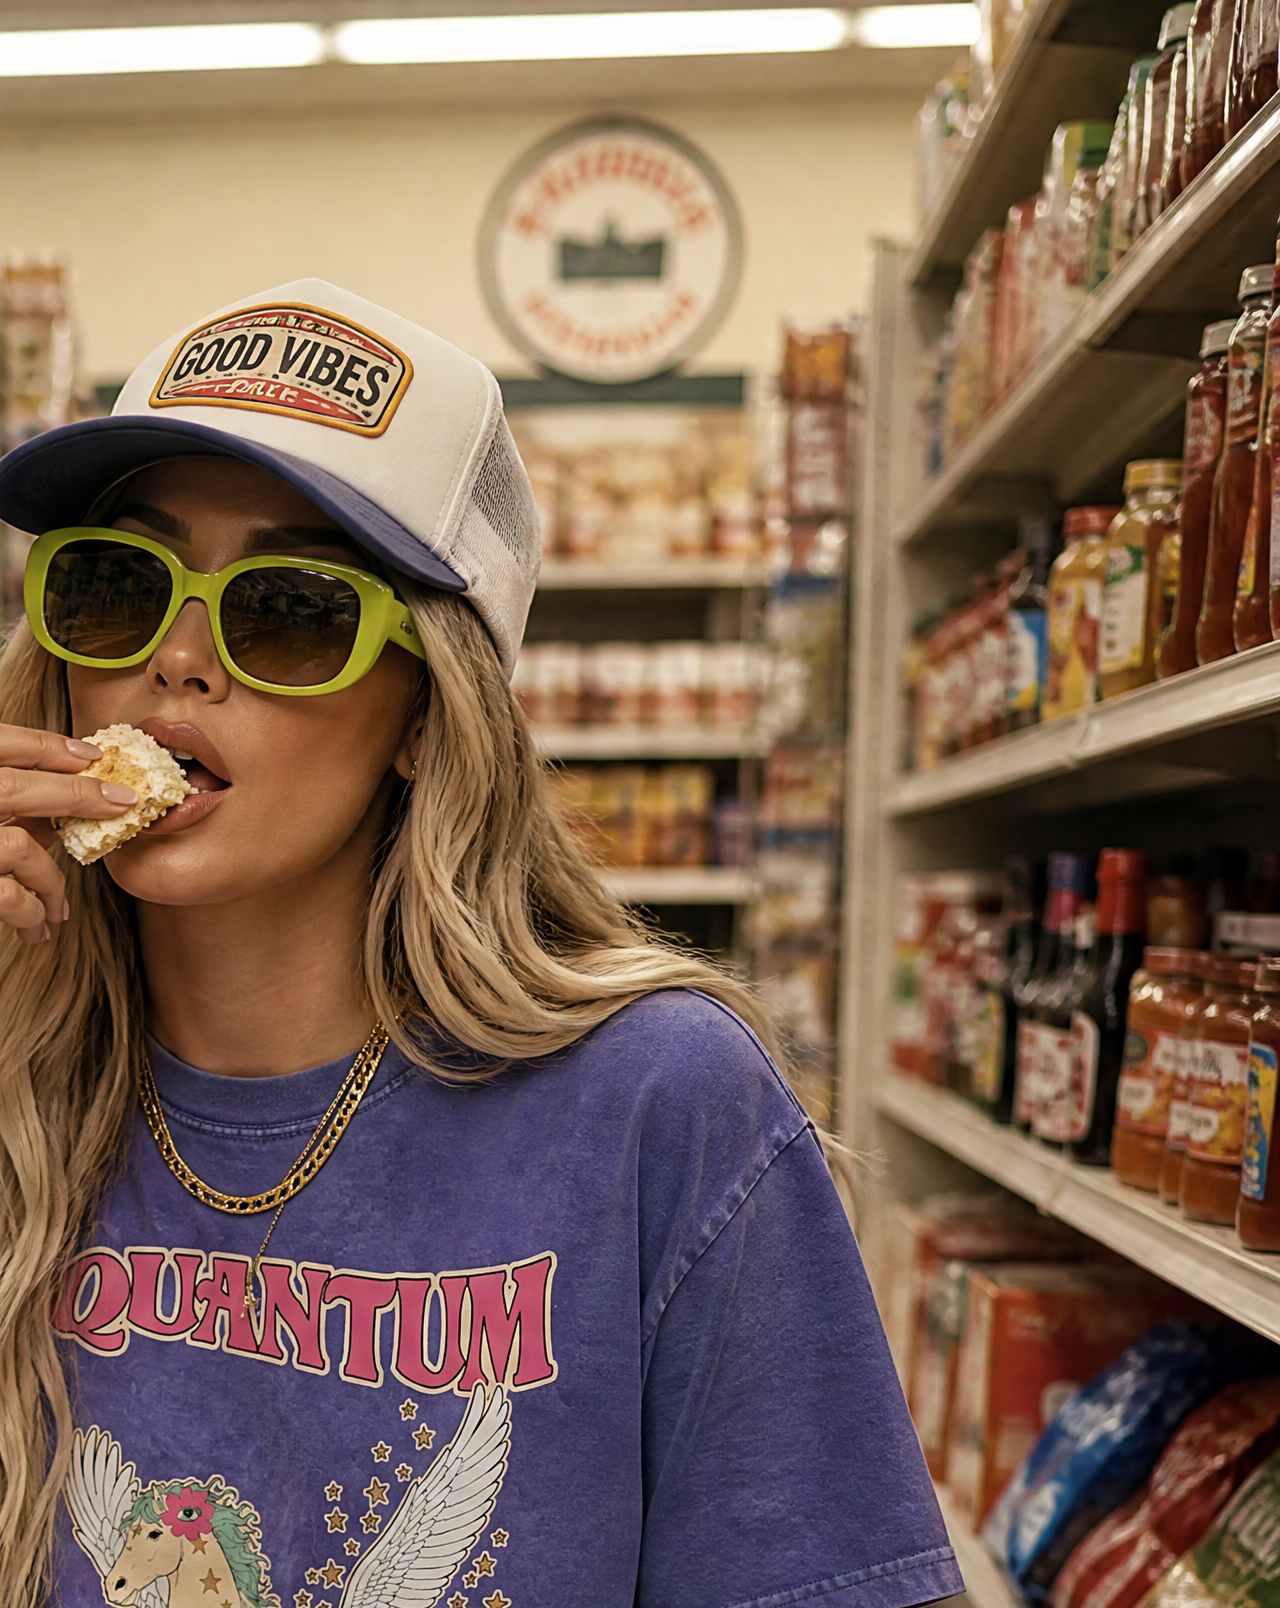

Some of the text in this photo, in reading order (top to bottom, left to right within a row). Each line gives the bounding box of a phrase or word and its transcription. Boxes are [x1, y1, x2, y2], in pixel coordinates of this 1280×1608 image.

[172, 333, 390, 407] GOOD VIBES
[52, 1246, 558, 1396] QUANTUM
